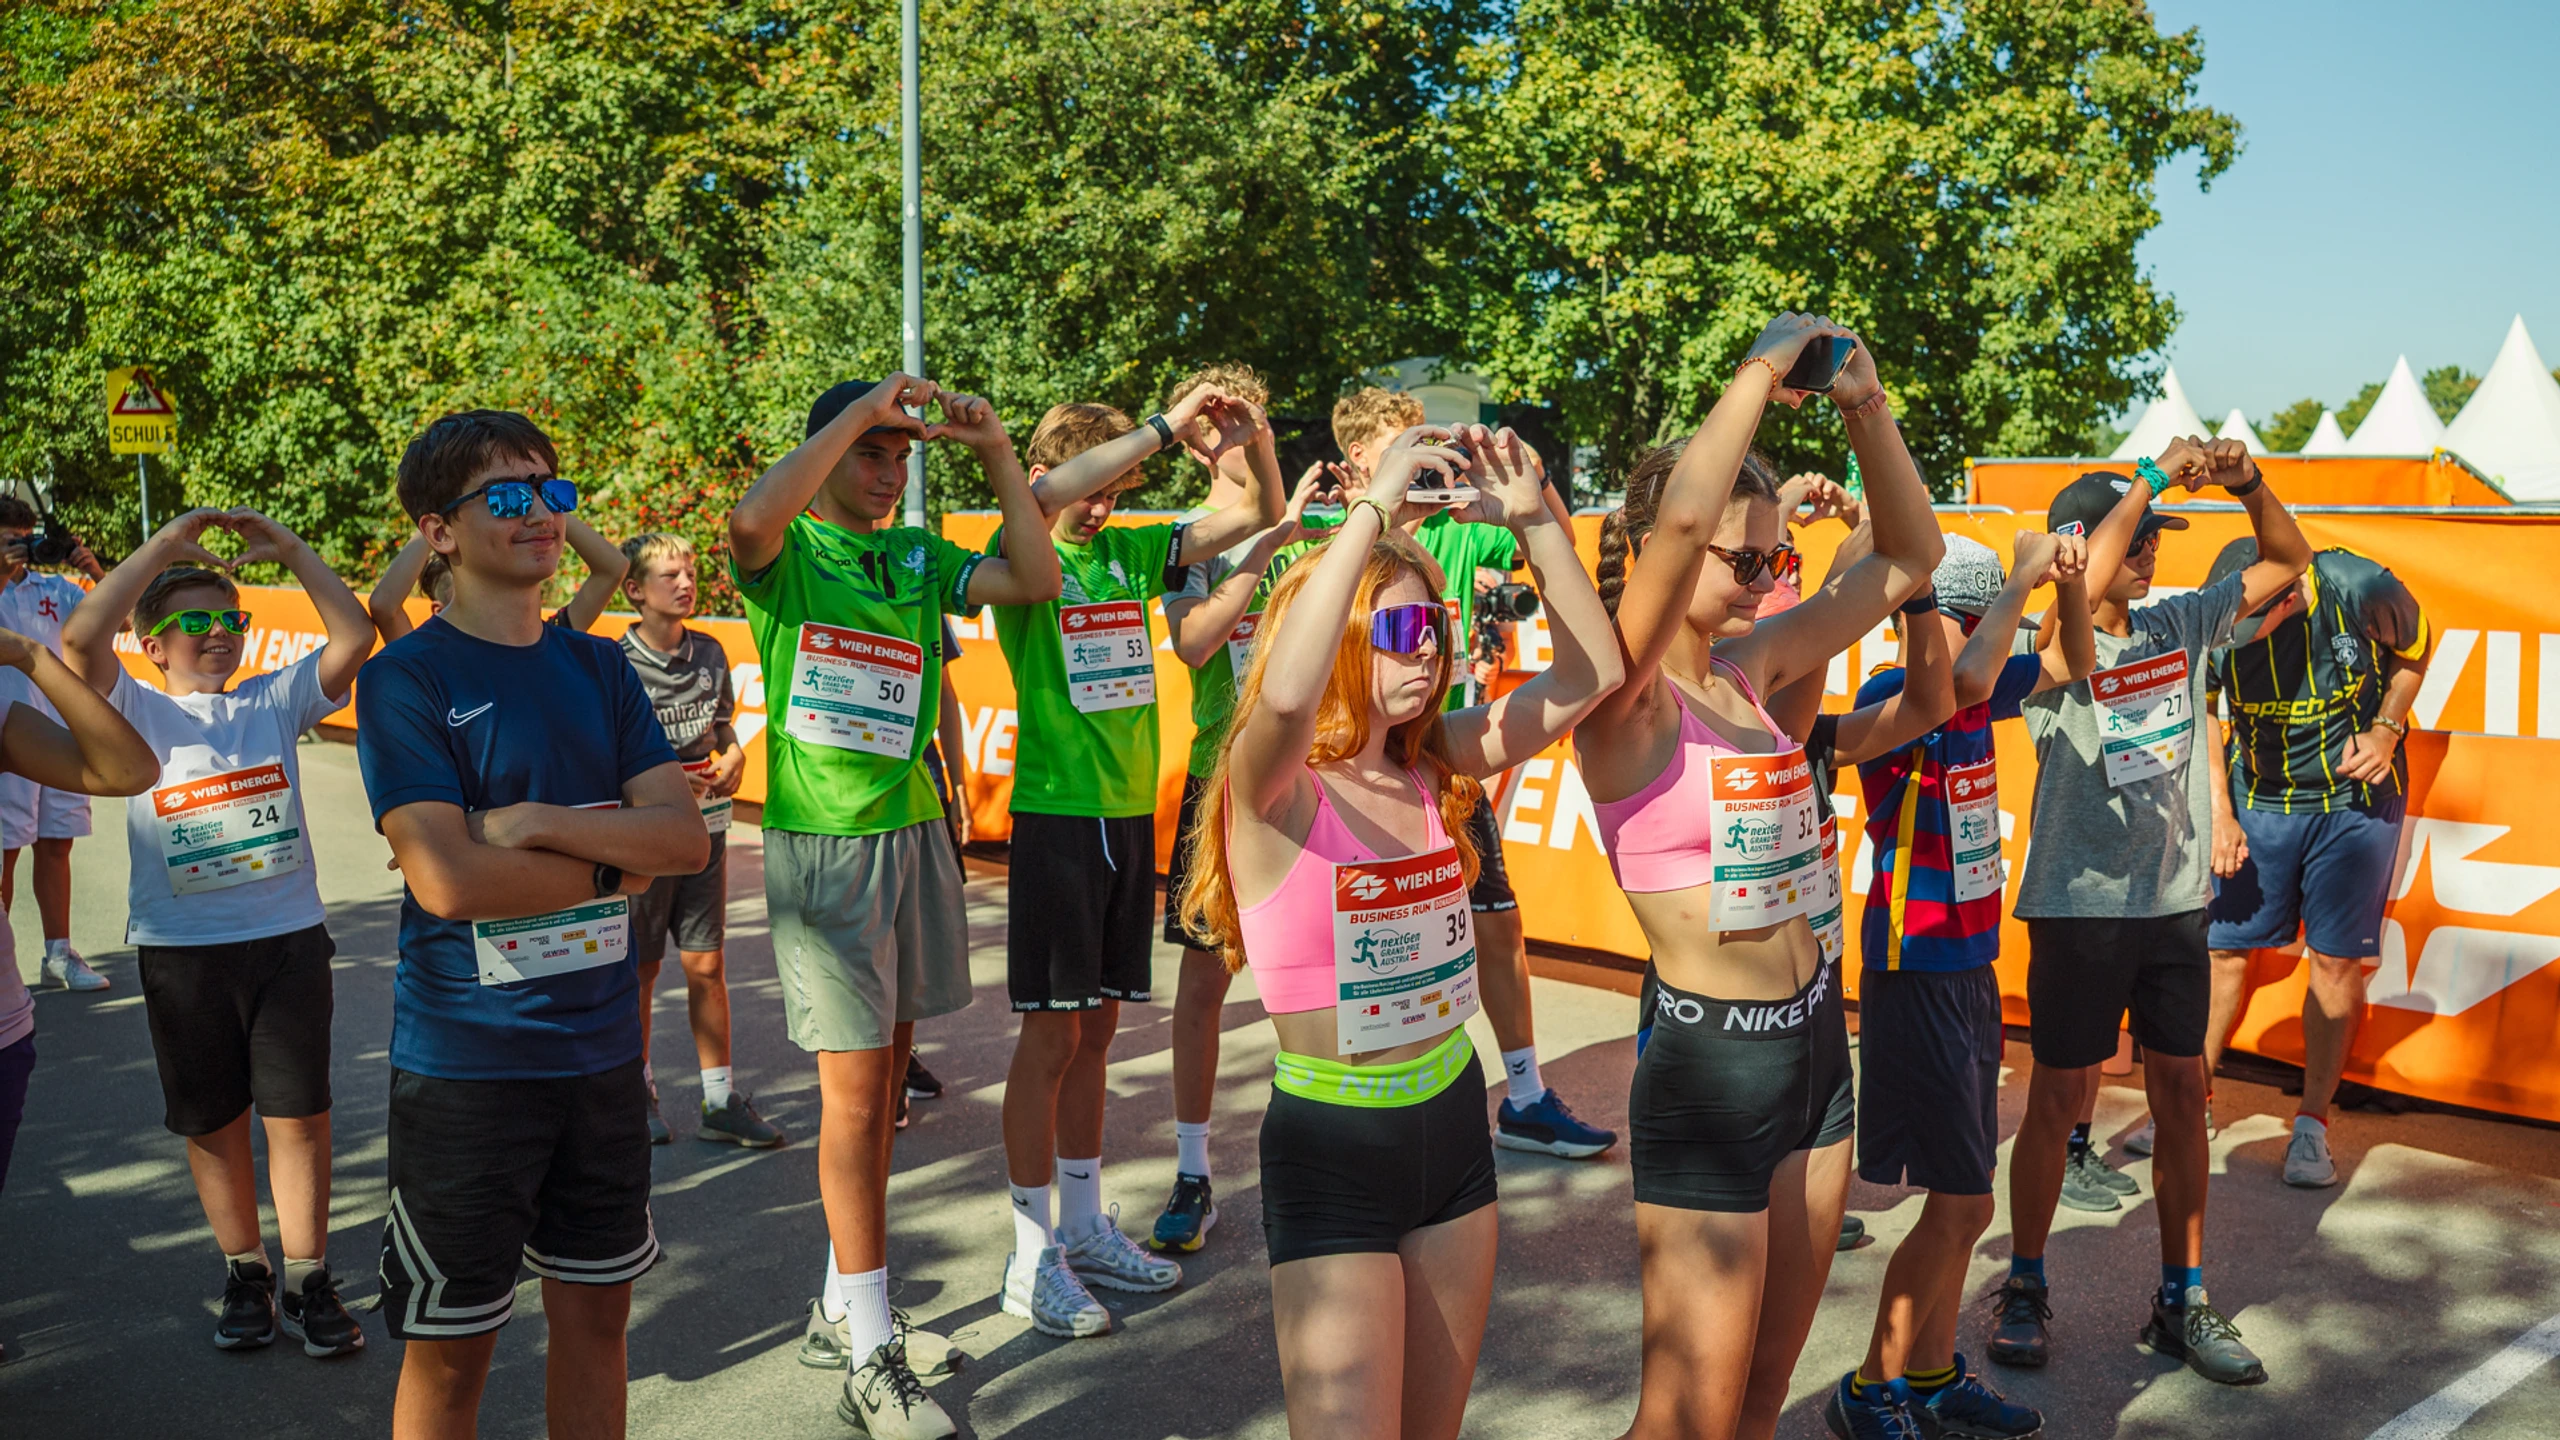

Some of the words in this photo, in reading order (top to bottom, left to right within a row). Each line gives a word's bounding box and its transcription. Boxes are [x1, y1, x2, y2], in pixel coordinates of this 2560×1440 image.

[113, 425, 173, 443] SCHULE
[1168, 538, 1179, 566] Kempa
[956, 564, 972, 596] Kempa
[1090, 613, 1115, 623] WIEN
[838, 638, 872, 654] WIEN
[874, 646, 918, 666] ENERGIE
[1126, 638, 1143, 658] 53
[806, 654, 848, 667] BUSINESS
[850, 661, 867, 670] RUN
[822, 673, 855, 685] nextGen
[2123, 670, 2150, 686] WIEN
[2151, 660, 2185, 679] ENERGIE
[877, 679, 905, 704] 50
[654, 698, 720, 724] mirates
[2164, 693, 2182, 717] 27
[2243, 697, 2325, 718] apsch
[191, 783, 228, 800] WIEN
[230, 772, 282, 792] ENERGIE
[1765, 769, 1792, 786] WIEN
[166, 806, 209, 823] BUSINESS
[211, 802, 230, 812] RUN
[249, 804, 280, 828] 24
[1724, 801, 1777, 812] BUSINESS
[1779, 799, 1791, 809] RUN
[190, 820, 223, 833] nextGen
[1750, 823, 1782, 836] nextGen
[1798, 806, 1813, 840] 32
[1393, 869, 1433, 892] WIEN
[1828, 870, 1838, 899] 26
[1349, 907, 1409, 924] BUSINESS
[1412, 902, 1431, 916] RUN
[1446, 908, 1467, 948] 39
[1380, 932, 1421, 948] nextGen
[1380, 945, 1404, 957] GRAND
[1406, 942, 1420, 952] PRIX
[1380, 954, 1409, 966] AUSTRIA
[1100, 987, 1122, 997] empa
[1049, 999, 1080, 1010] Kempa
[1656, 984, 1704, 1024] RO
[1723, 997, 1805, 1032] NIKE
[1337, 1059, 1438, 1099] NIKE
